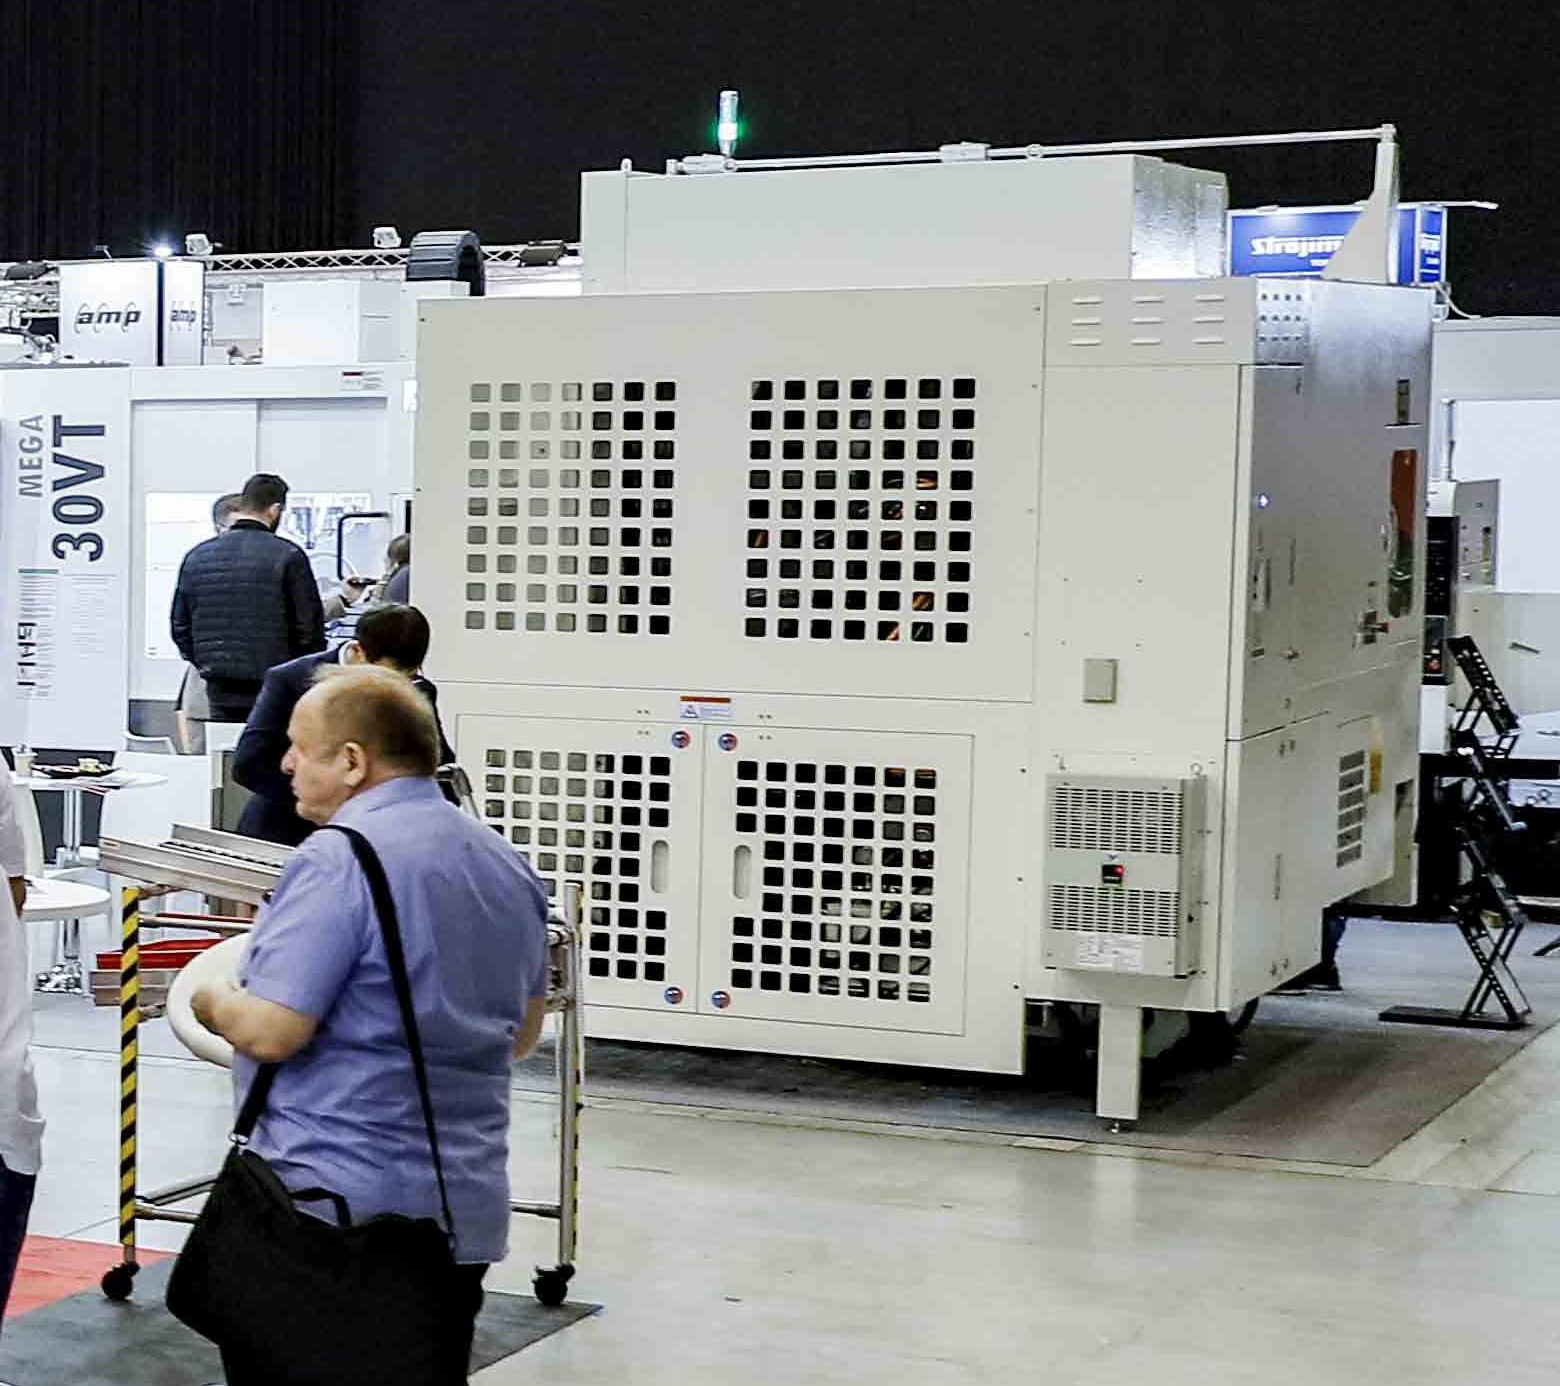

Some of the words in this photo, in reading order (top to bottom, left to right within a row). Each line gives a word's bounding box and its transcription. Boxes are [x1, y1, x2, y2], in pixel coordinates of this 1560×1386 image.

[77, 310, 141, 326] amp
[19, 415, 43, 497] MEGA
[52, 414, 106, 562] 30VT
